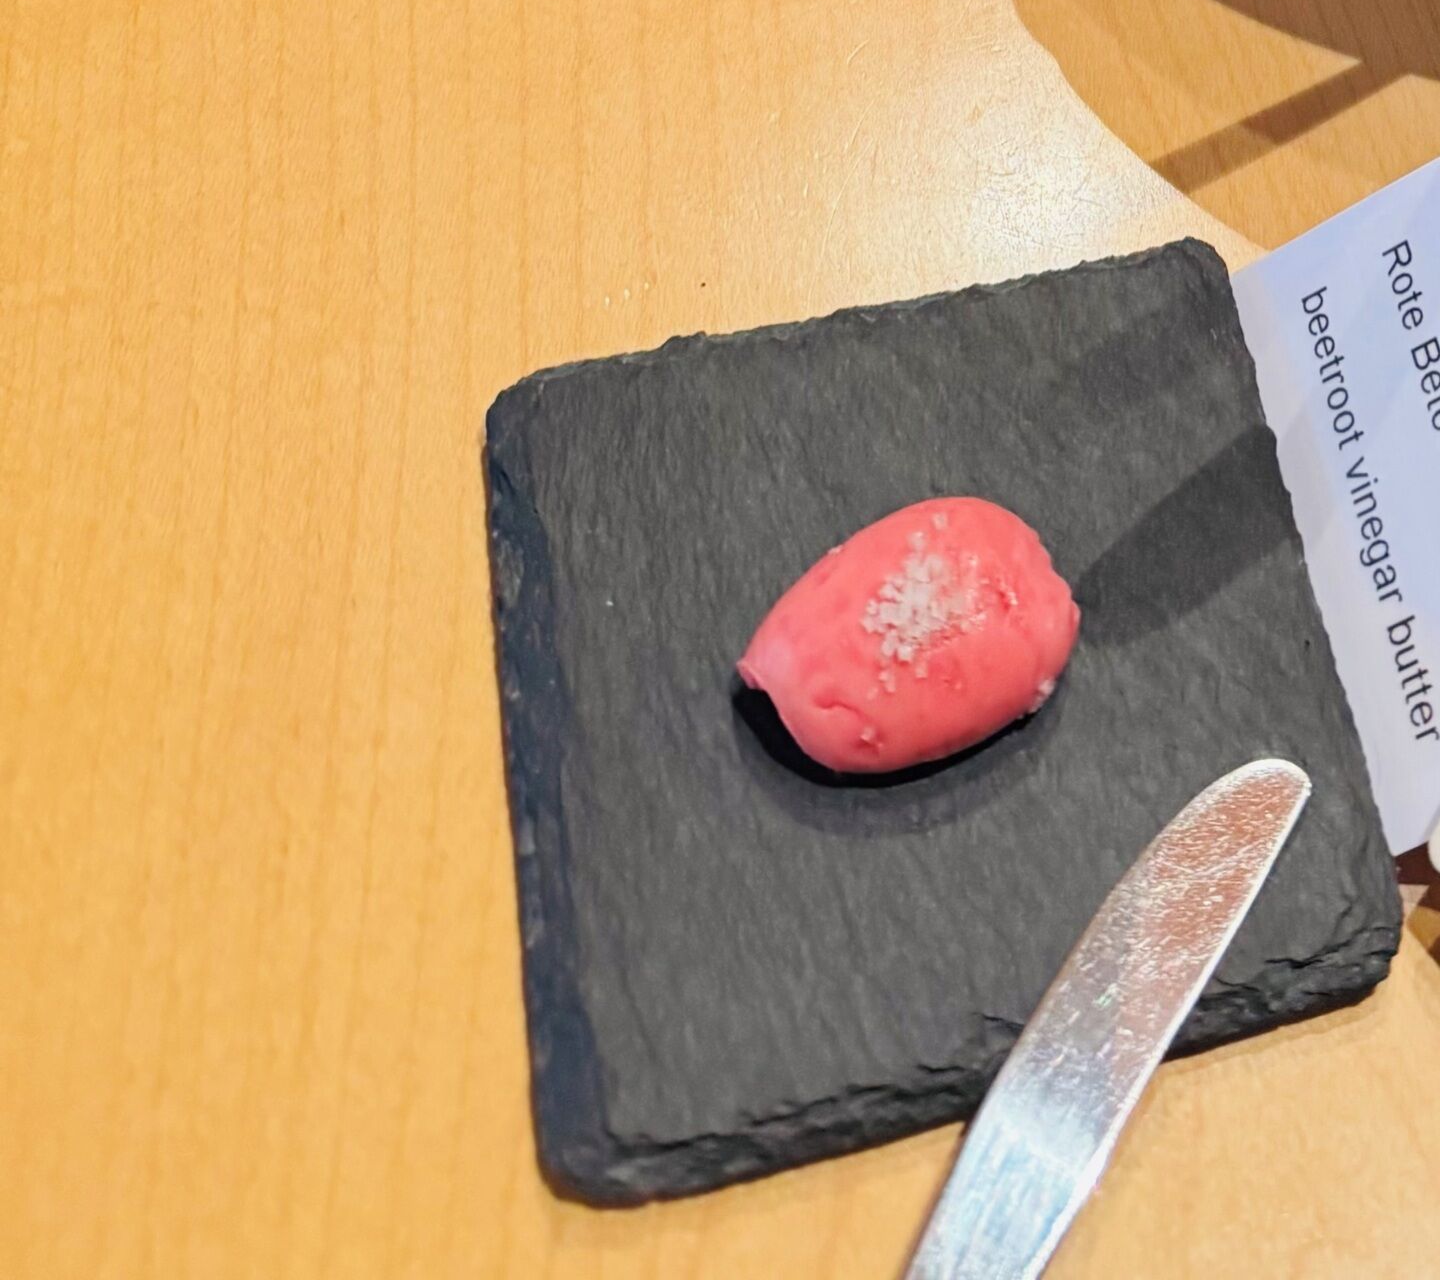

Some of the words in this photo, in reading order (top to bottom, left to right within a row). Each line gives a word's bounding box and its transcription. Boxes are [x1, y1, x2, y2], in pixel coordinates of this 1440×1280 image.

[1381, 239, 1424, 330] Rote
[1301, 286, 1365, 451] beetroot
[1345, 455, 1403, 602] vinegar
[1386, 614, 1440, 742] butter
